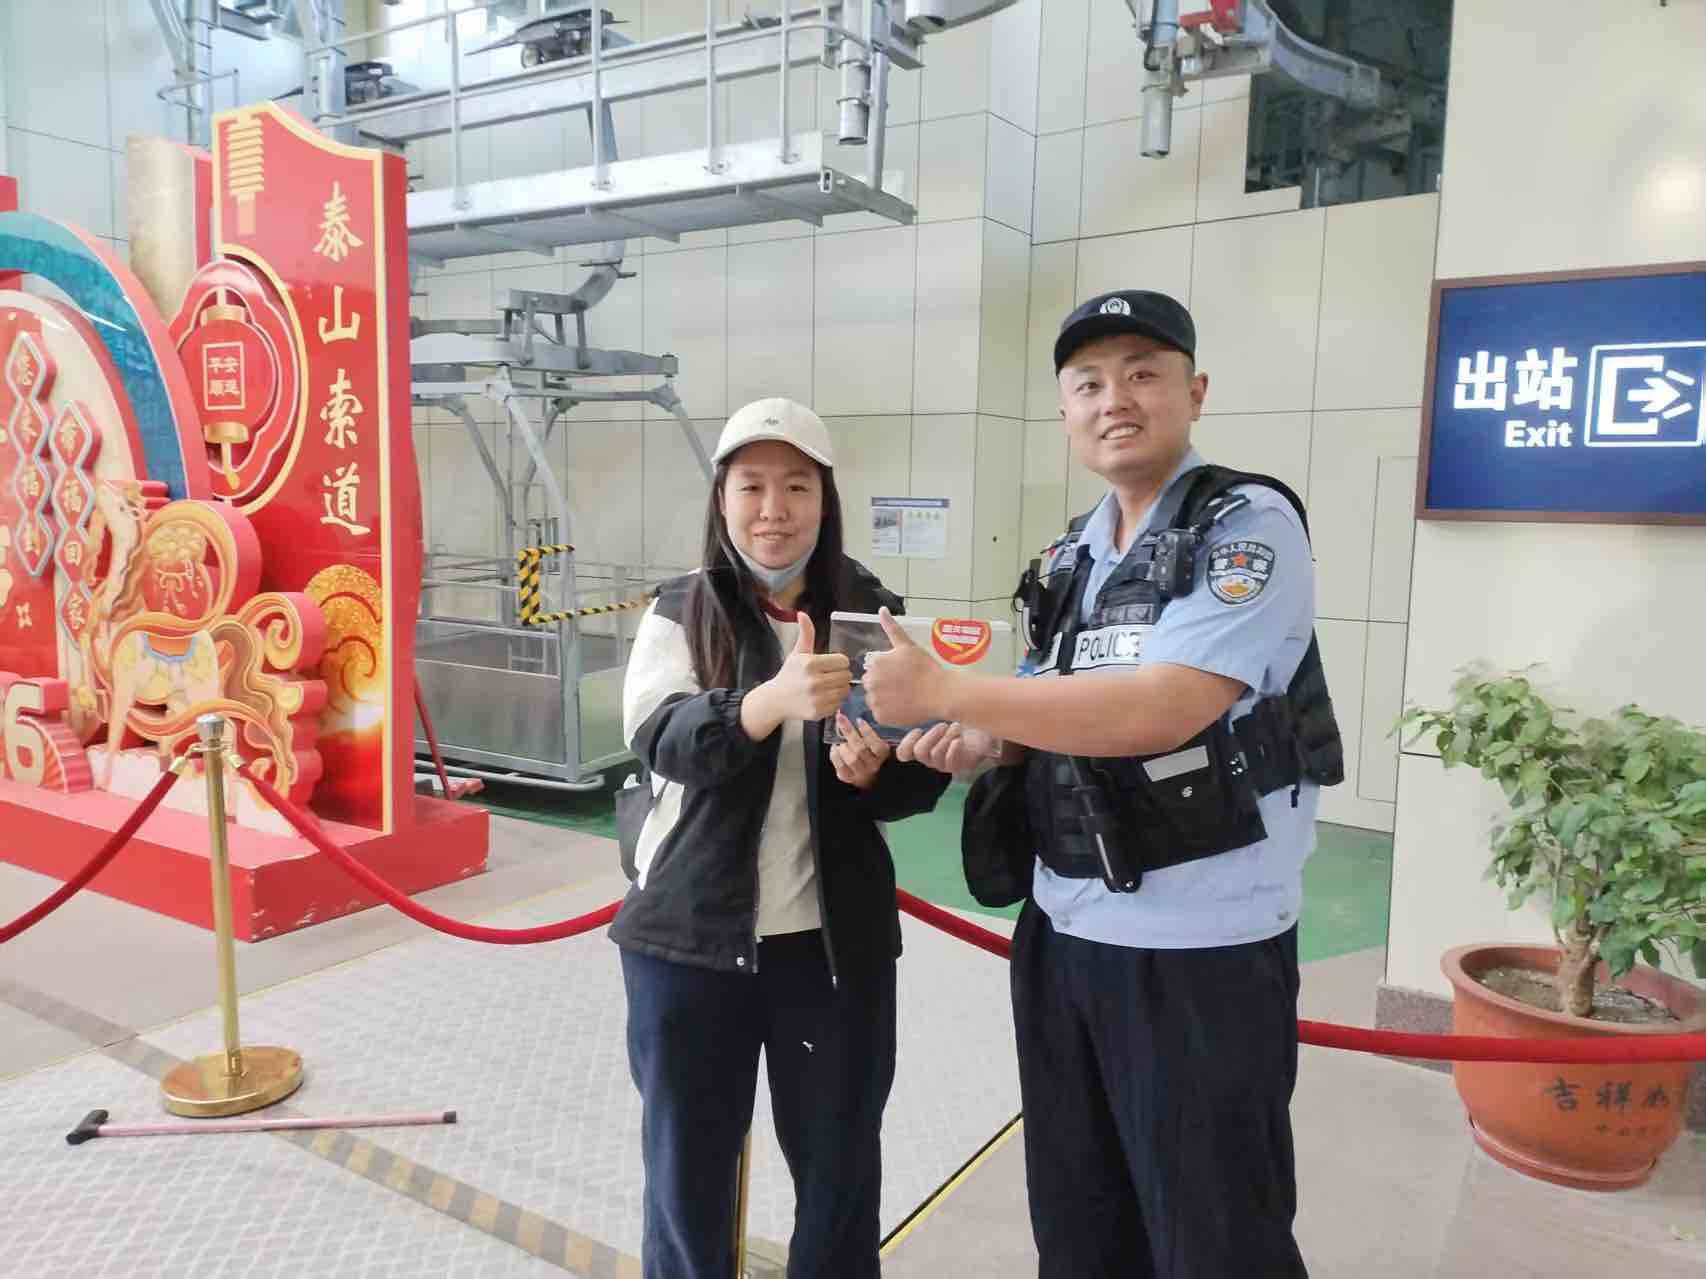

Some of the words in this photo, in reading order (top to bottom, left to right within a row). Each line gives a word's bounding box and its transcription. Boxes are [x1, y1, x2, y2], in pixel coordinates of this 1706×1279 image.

[312, 180, 371, 536] 泰山索道
[1453, 347, 1578, 410] 出站
[1504, 420, 1573, 448] Exit
